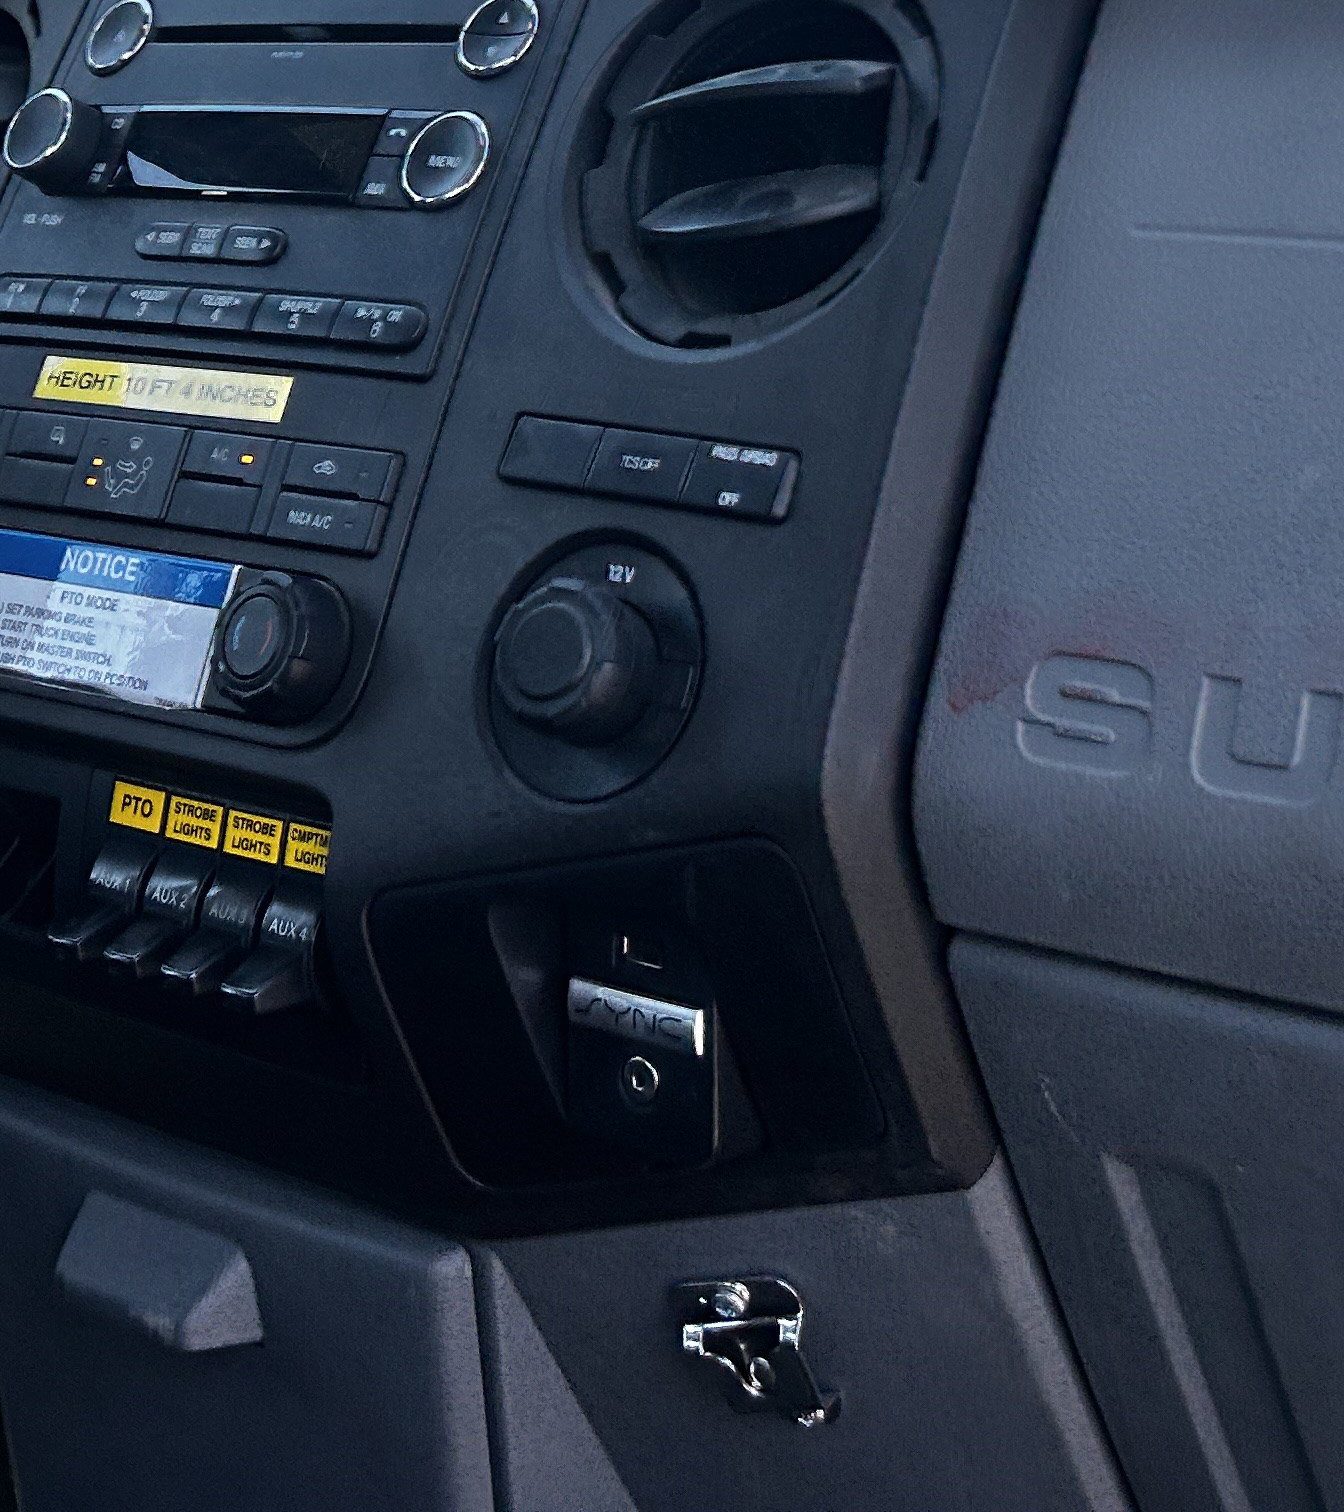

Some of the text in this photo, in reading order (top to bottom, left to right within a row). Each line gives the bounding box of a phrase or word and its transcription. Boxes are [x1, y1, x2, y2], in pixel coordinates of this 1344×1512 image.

[426, 154, 461, 169] MENU
[47, 370, 279, 408] HEIGHT 10 FT 4 INCHES
[717, 490, 742, 507] OFF
[59, 546, 141, 582] NOTICE
[60, 590, 120, 611] PTO MODE
[5, 602, 24, 615] SET
[23, 605, 62, 622] PARKING
[0, 618, 28, 633] START
[30, 623, 60, 638] TRUCK
[21, 638, 36, 651] ON
[36, 642, 73, 659] MASTER
[16, 654, 36, 668] PTO
[37, 658, 72, 675] SWITCH
[73, 665, 87, 679] TO
[88, 669, 103, 682] ON
[121, 793, 154, 818] PTO
[174, 801, 217, 823] STROBE
[173, 820, 212, 841] LIGHTS
[232, 815, 277, 838] STROBE
[231, 835, 272, 856] LIGHTS
[96, 876, 122, 892] AUX
[151, 887, 189, 909] AUX 2
[209, 902, 248, 924] AUX 3
[268, 917, 308, 941] AUX 4
[574, 996, 684, 1040] SYNC
